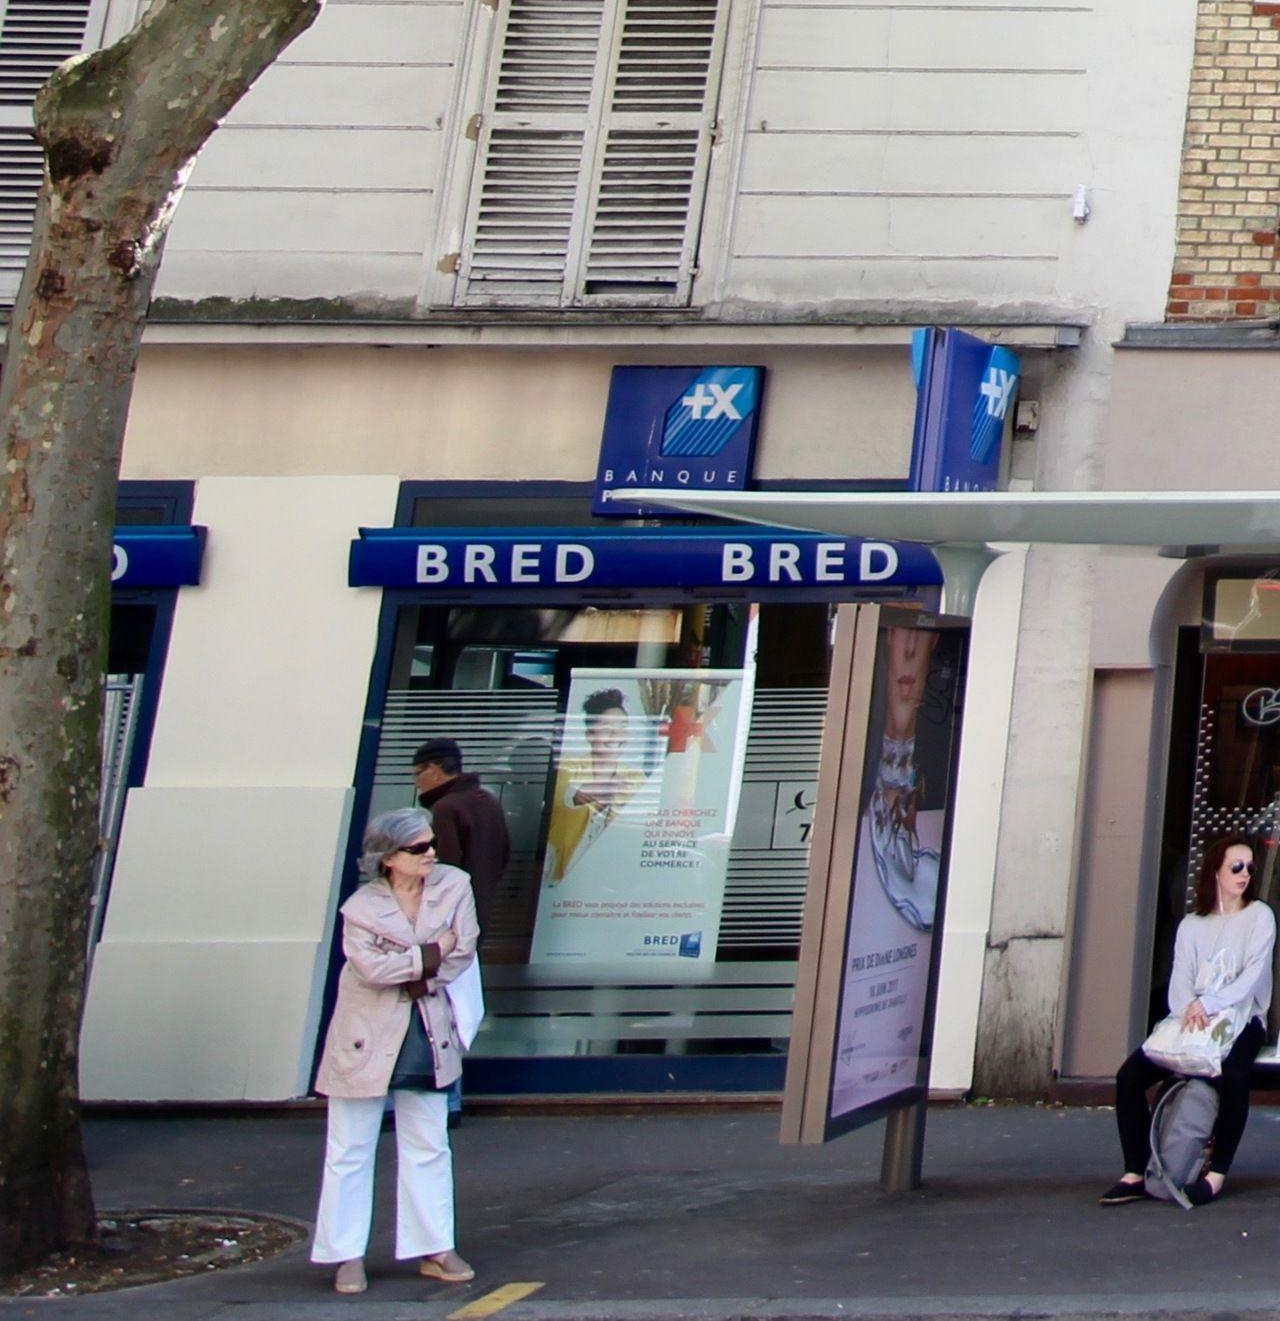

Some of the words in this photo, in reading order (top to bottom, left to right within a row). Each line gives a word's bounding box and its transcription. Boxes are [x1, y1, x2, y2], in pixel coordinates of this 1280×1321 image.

[603, 470, 738, 484] BANQUE
[416, 544, 597, 584] BRED
[722, 542, 900, 582] BRED
[665, 820, 702, 828] BANQUE
[642, 840, 656, 848] AU
[641, 850, 655, 858] DE
[644, 935, 679, 945] BRED
